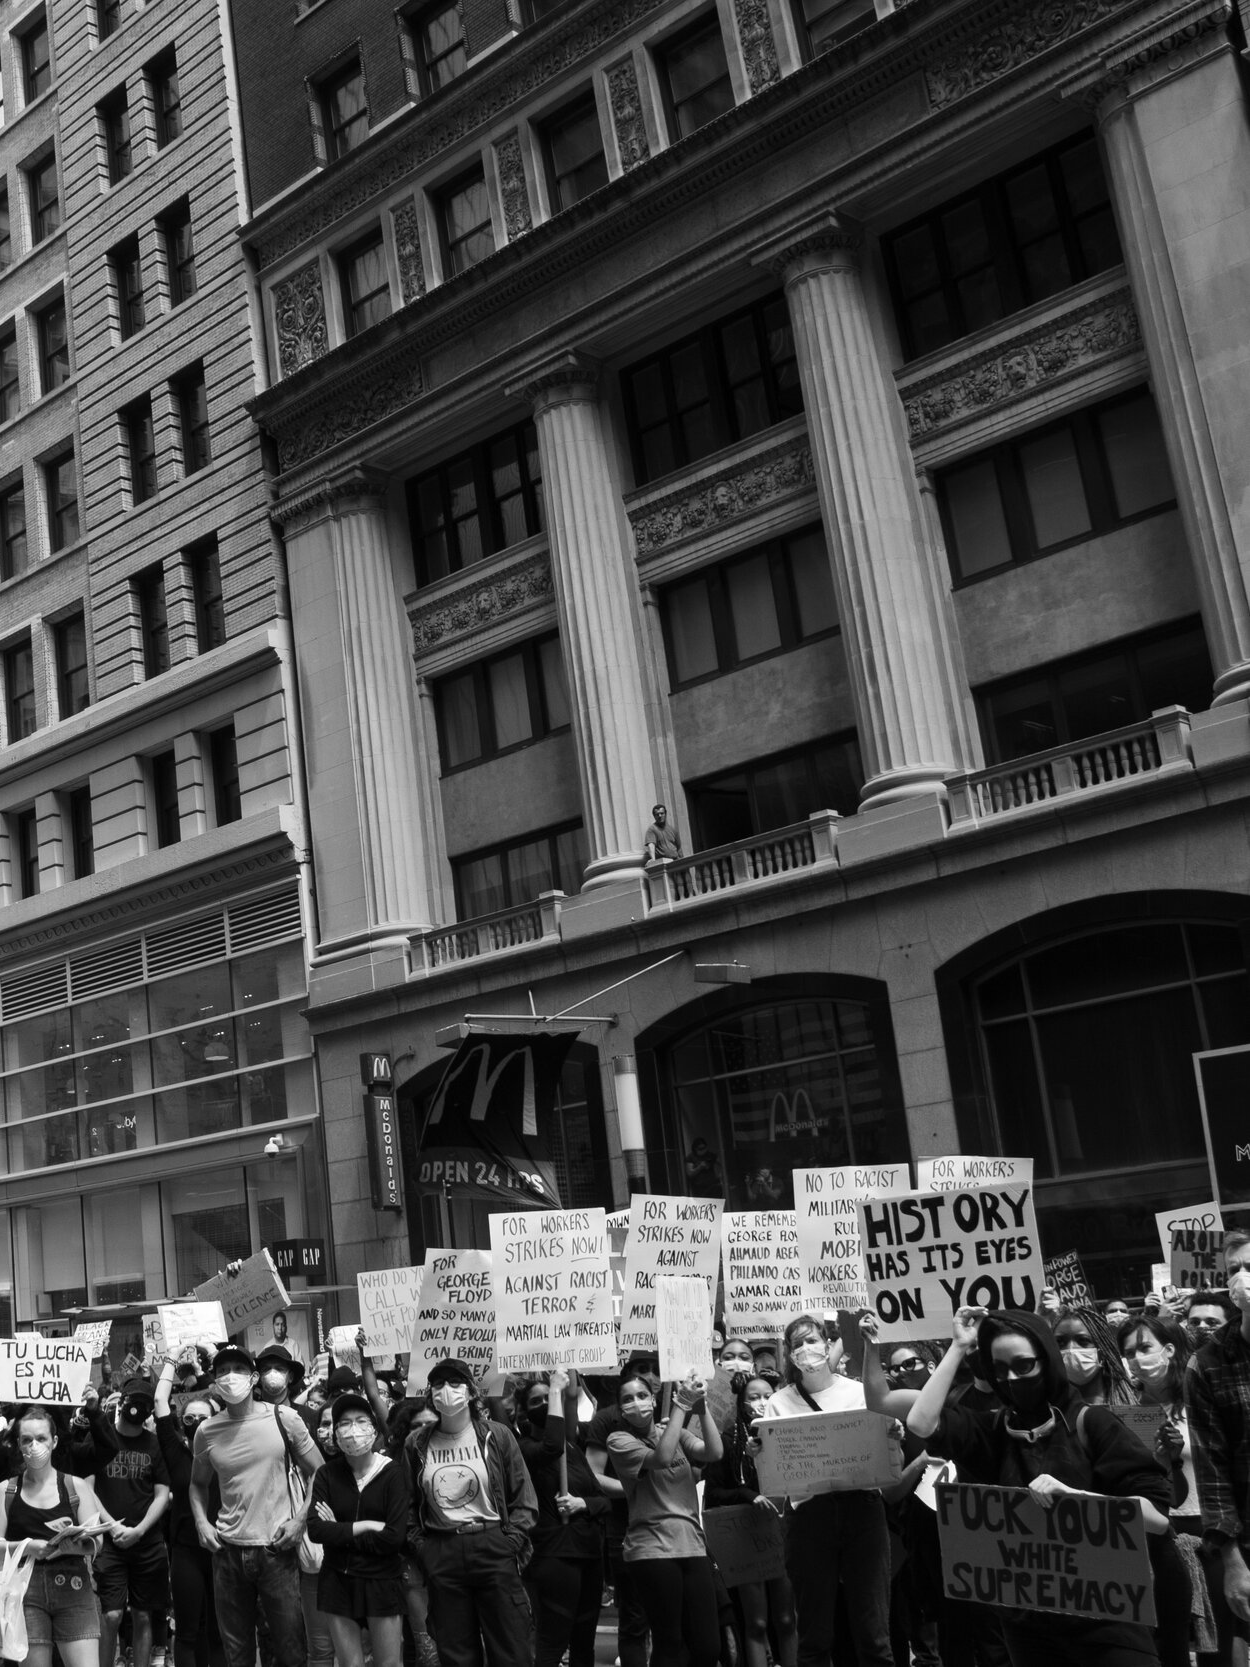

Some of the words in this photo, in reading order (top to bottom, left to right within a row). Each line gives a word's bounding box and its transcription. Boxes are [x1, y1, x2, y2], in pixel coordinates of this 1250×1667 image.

[379, 1099, 398, 1204] McDonald's
[419, 1160, 469, 1183] OPEN
[475, 1161, 500, 1186] 24
[932, 1160, 955, 1178] FOR
[963, 1160, 1015, 1179] WORKERS
[805, 1173, 823, 1193] NO
[829, 1172, 845, 1191] TO
[854, 1169, 900, 1189] RACIST
[643, 1201, 667, 1220] FOR
[676, 1203, 717, 1223] WORKERS
[731, 1216, 747, 1228] WE
[754, 1213, 797, 1228] REMEMB
[863, 1189, 1030, 1249] HISTORY
[502, 1216, 527, 1236] FOR
[540, 1213, 590, 1234] WORKERS
[637, 1225, 684, 1243] STRIKES
[689, 1229, 712, 1245] NOW
[727, 1230, 772, 1244] GEORGE
[277, 1249, 293, 1267] GAP
[302, 1248, 320, 1266] GAP
[505, 1236, 564, 1263] STRIKES
[571, 1235, 604, 1256] NOW!
[656, 1249, 699, 1268] AGAINST
[729, 1246, 771, 1261] AHMAUD
[776, 1245, 799, 1260] ABER
[866, 1251, 910, 1282] HAS
[918, 1242, 964, 1274] ITS
[975, 1236, 1032, 1266] EYES
[432, 1255, 458, 1274] FOR
[1052, 1252, 1078, 1270] POWER
[1192, 1252, 1217, 1270] THE
[360, 1272, 388, 1289] WHO
[392, 1270, 407, 1285] DO
[412, 1266, 425, 1284] YO
[437, 1271, 491, 1290] GEORGE
[505, 1271, 562, 1294] AGAINST
[570, 1269, 608, 1289] RACIST
[730, 1265, 779, 1281] PHILANDO
[782, 1266, 801, 1280] CAS
[808, 1263, 858, 1283] WORKERS
[1046, 1264, 1082, 1289] ORGE
[364, 1288, 405, 1312] CALL
[448, 1289, 492, 1304] FLOYD
[730, 1285, 771, 1299] JAMAR
[876, 1287, 925, 1324] ON
[939, 1274, 1036, 1318] YOU
[227, 1287, 278, 1323] IOLENCE
[521, 1295, 578, 1316] TERROR
[732, 1303, 750, 1313] AND
[752, 1302, 764, 1313] SO
[765, 1300, 787, 1312] MANY
[370, 1309, 397, 1329] THE
[419, 1308, 440, 1320] AND
[441, 1309, 456, 1320] SO
[460, 1310, 486, 1323] MANY
[316, 1308, 325, 1352] Newsstand
[420, 1326, 450, 1342] ONLY
[506, 1323, 549, 1342] MARTIAL
[554, 1322, 571, 1339] LAW
[574, 1321, 614, 1337] THREATS!
[730, 1324, 785, 1335] INTERNATIONALIST
[367, 1333, 390, 1349] ARE
[1, 1341, 27, 1359] TU
[36, 1344, 88, 1362] LUCHA
[424, 1346, 451, 1360] CAN
[457, 1345, 493, 1362] BRING
[498, 1348, 575, 1369] INTERNATIONALIST
[578, 1346, 606, 1363] GROUP
[15, 1361, 34, 1378] ES
[42, 1363, 61, 1378] MI
[14, 1380, 72, 1403] LUCHA
[429, 1446, 479, 1464] NIRVANA
[106, 1464, 146, 1480] UPDATE
[937, 1485, 1034, 1535] FUCK
[1043, 1493, 1138, 1550] YOUR
[997, 1539, 1078, 1576] WHITE
[947, 1561, 1147, 1622] SUPREMACY
